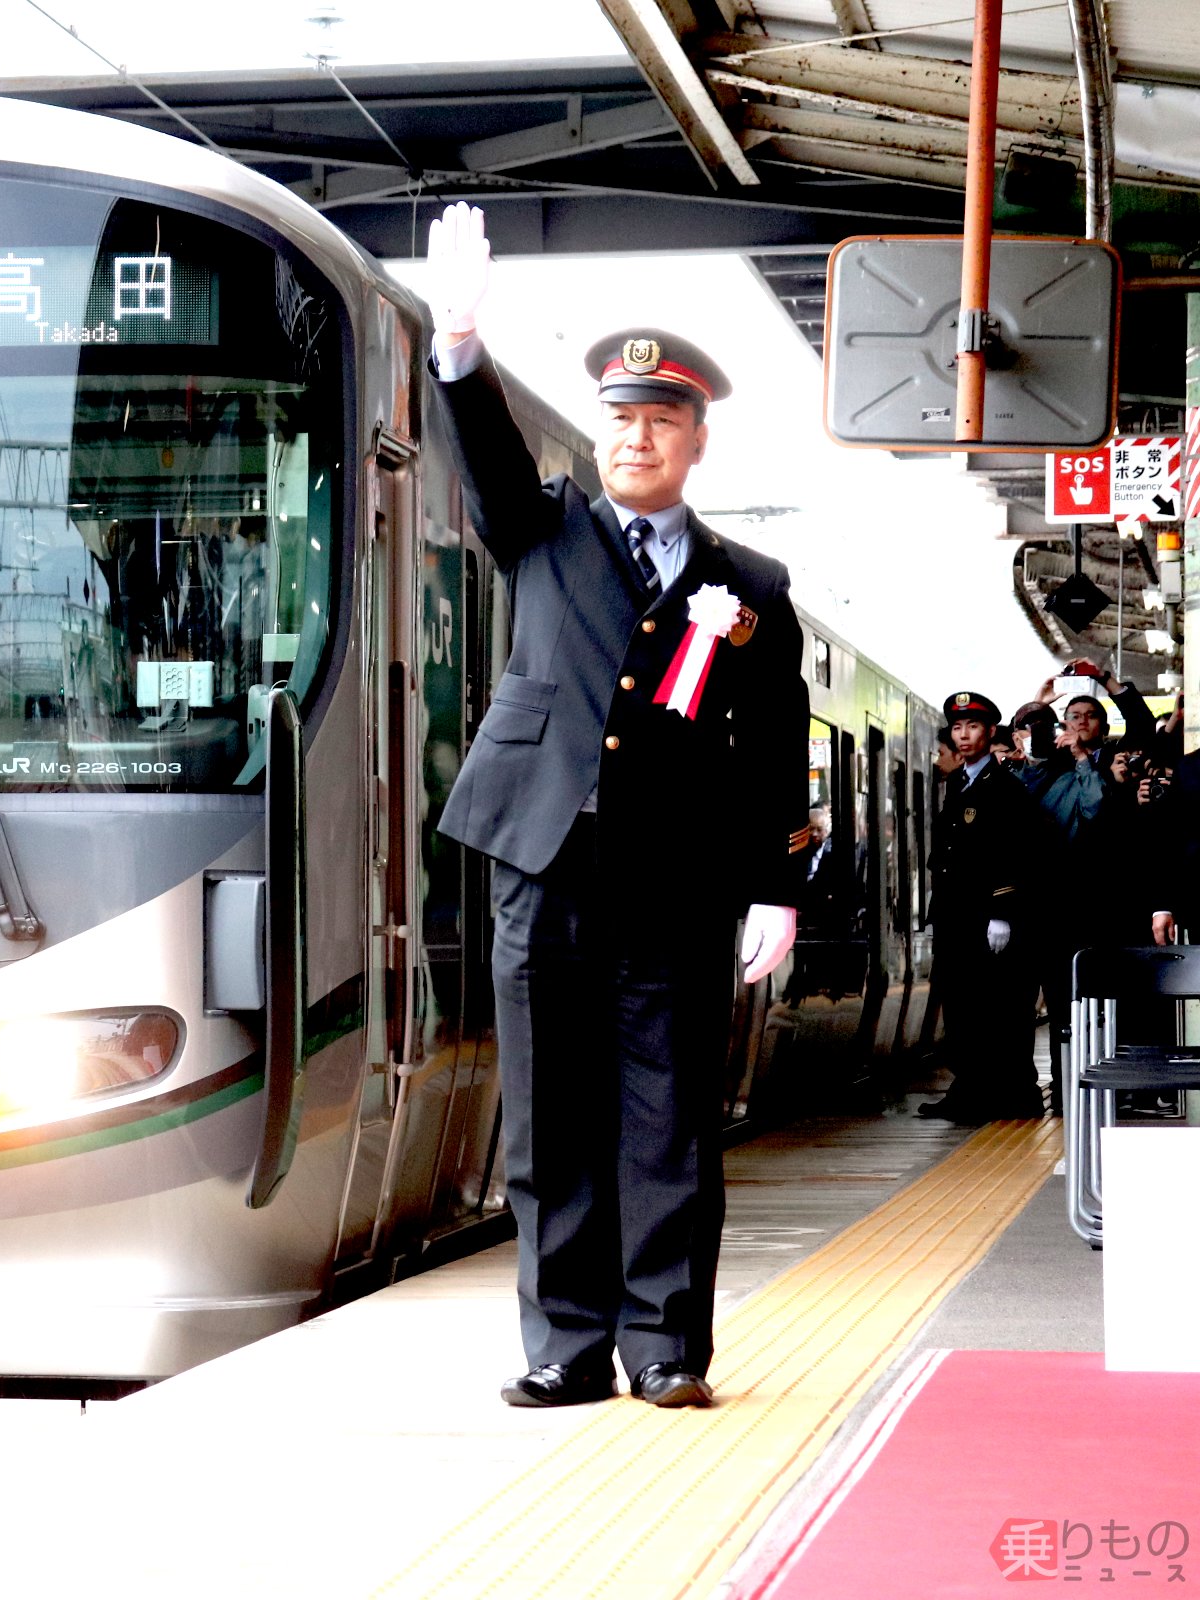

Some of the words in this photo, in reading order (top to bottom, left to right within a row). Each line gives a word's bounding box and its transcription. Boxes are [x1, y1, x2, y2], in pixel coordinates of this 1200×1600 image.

[34, 321, 119, 343] Takada
[1115, 449, 1162, 464] 非常
[1060, 457, 1105, 474] SOS
[1115, 466, 1162, 480] ボタン
[1114, 483, 1163, 492] Emergency
[1114, 493, 1144, 501] Button
[431, 597, 453, 668] JR
[1, 757, 32, 774] JR
[40, 762, 72, 774] M'c
[77, 762, 183, 774] 226-1003
